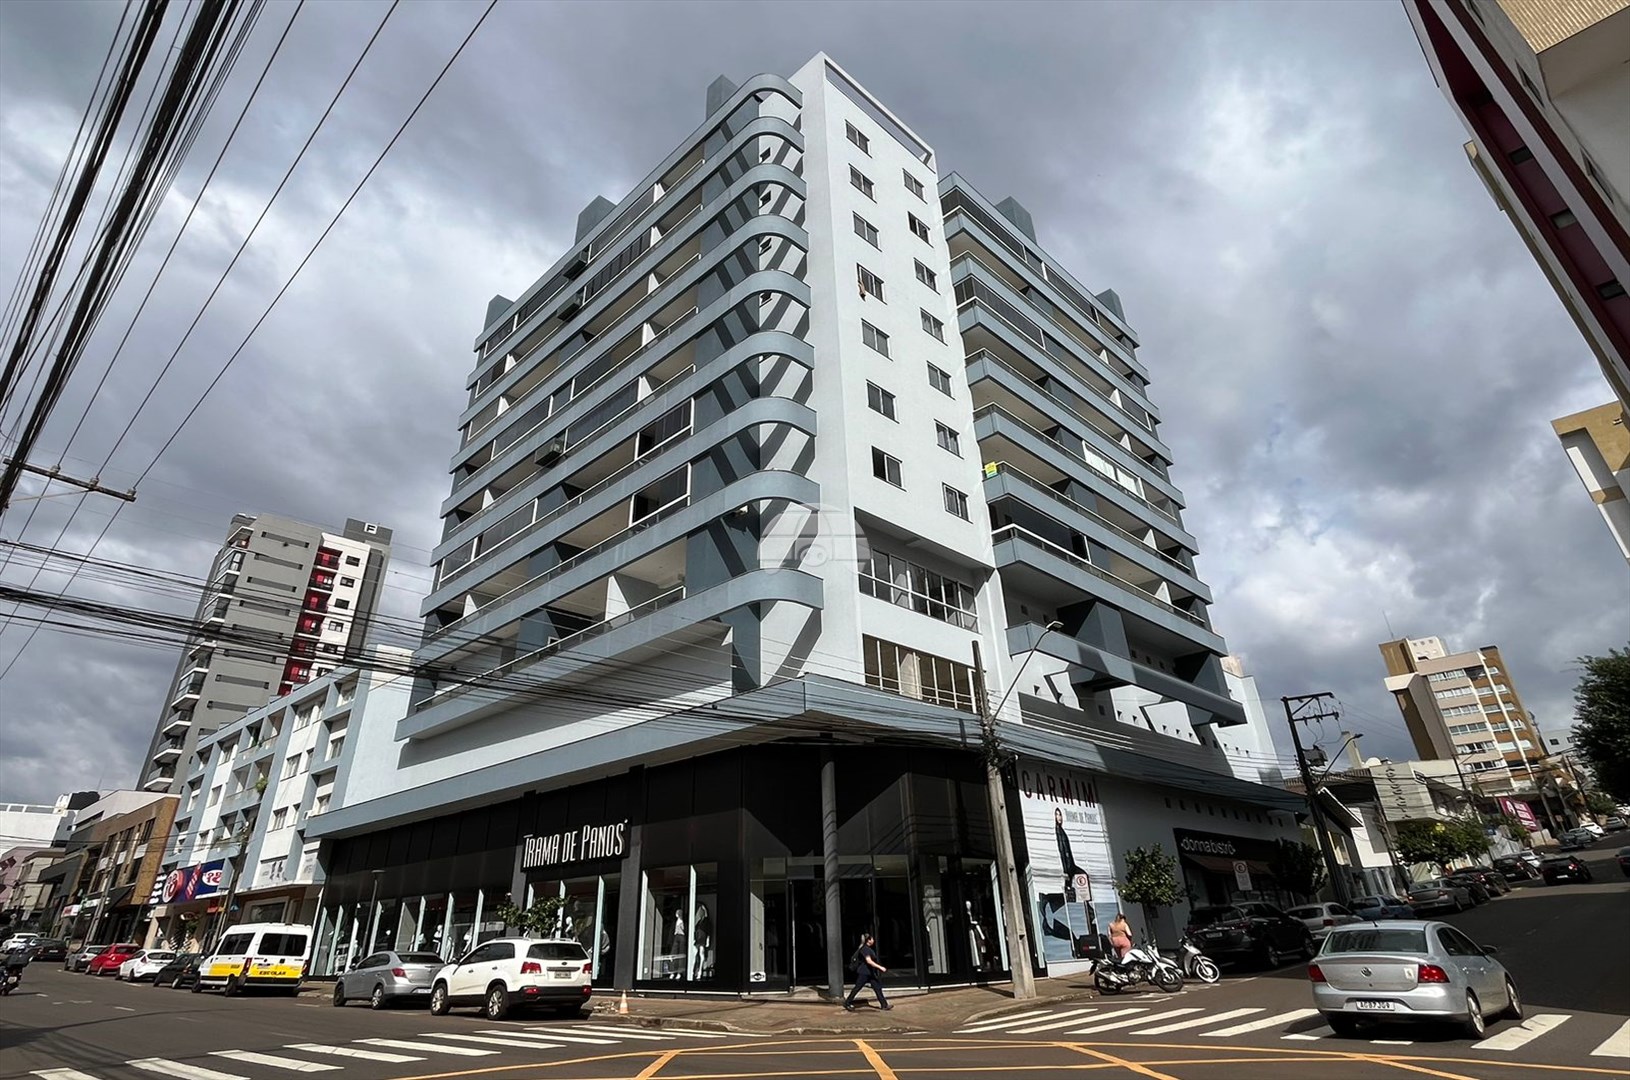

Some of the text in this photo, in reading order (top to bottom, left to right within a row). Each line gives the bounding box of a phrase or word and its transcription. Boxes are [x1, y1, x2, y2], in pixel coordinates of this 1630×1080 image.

[1022, 770, 1096, 809] CARMIM
[523, 823, 625, 868] TRAMA DE PANOS
